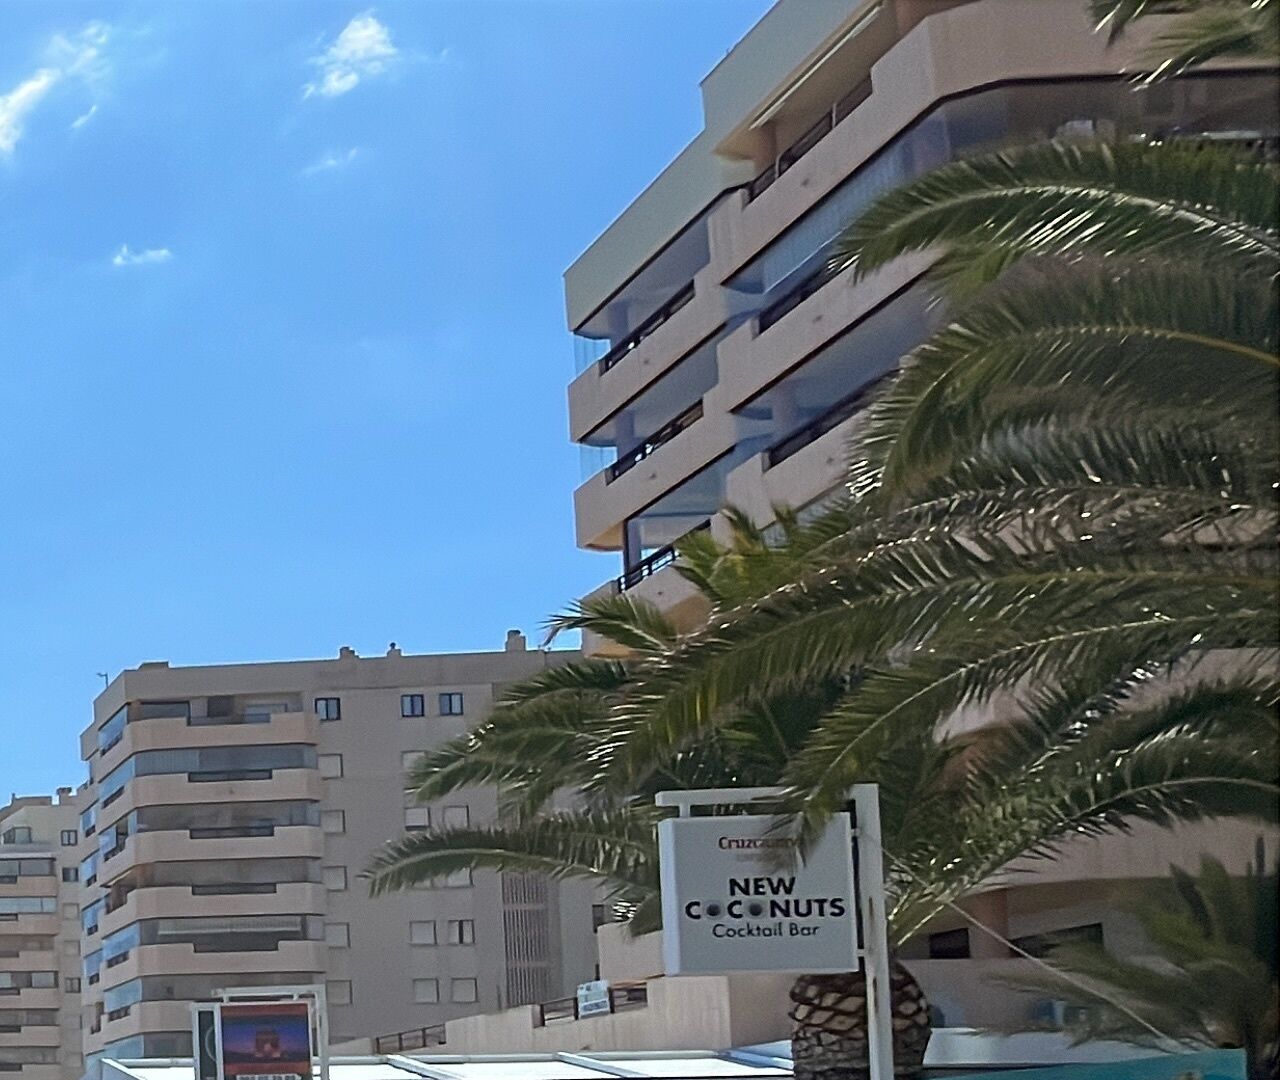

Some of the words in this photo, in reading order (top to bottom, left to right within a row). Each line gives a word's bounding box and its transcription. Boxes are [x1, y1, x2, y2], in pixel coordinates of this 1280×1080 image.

[729, 877, 796, 896] NEW
[685, 898, 845, 920] COCONUTS
[712, 922, 782, 938] Cocktail
[789, 922, 820, 937] Bar
